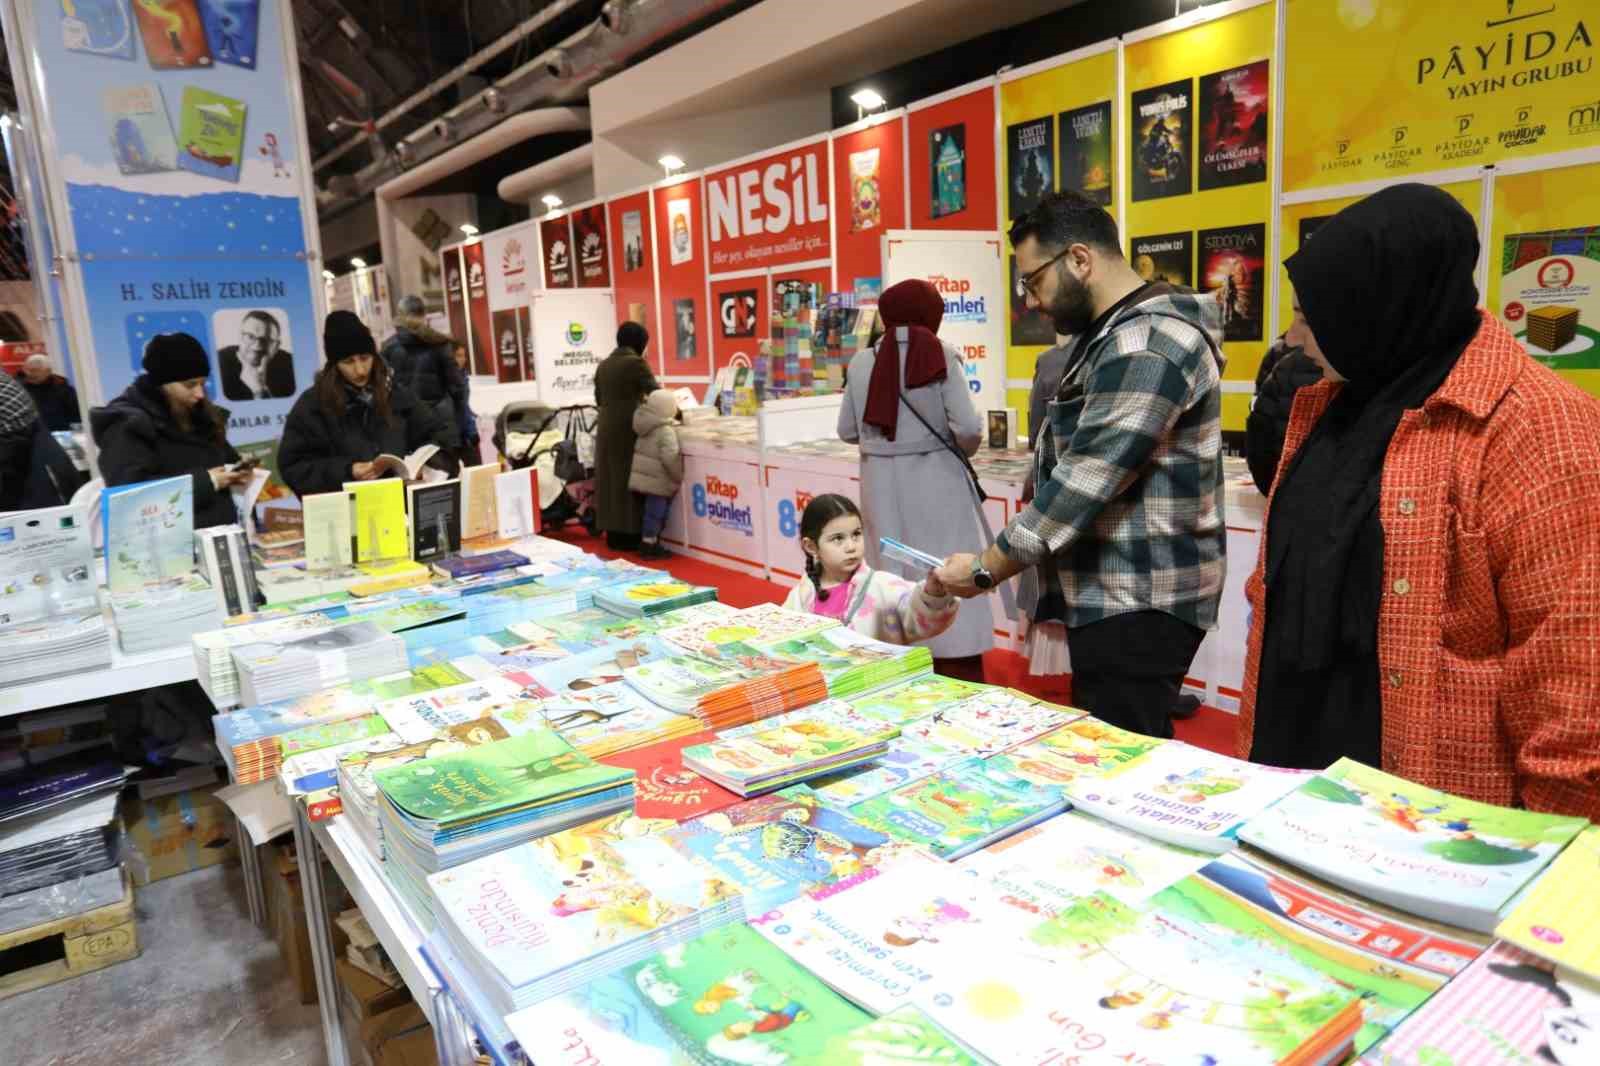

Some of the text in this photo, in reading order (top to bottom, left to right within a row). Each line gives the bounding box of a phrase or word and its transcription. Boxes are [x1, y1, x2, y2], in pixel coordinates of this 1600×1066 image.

[1447, 57, 1593, 100] YAYIN GRUBU
[121, 279, 285, 301] H. SALİH ZENGİN
[692, 482, 706, 518] 8
[707, 500, 752, 527] günleri
[706, 479, 738, 501] Kitap
[777, 499, 796, 538] 8
